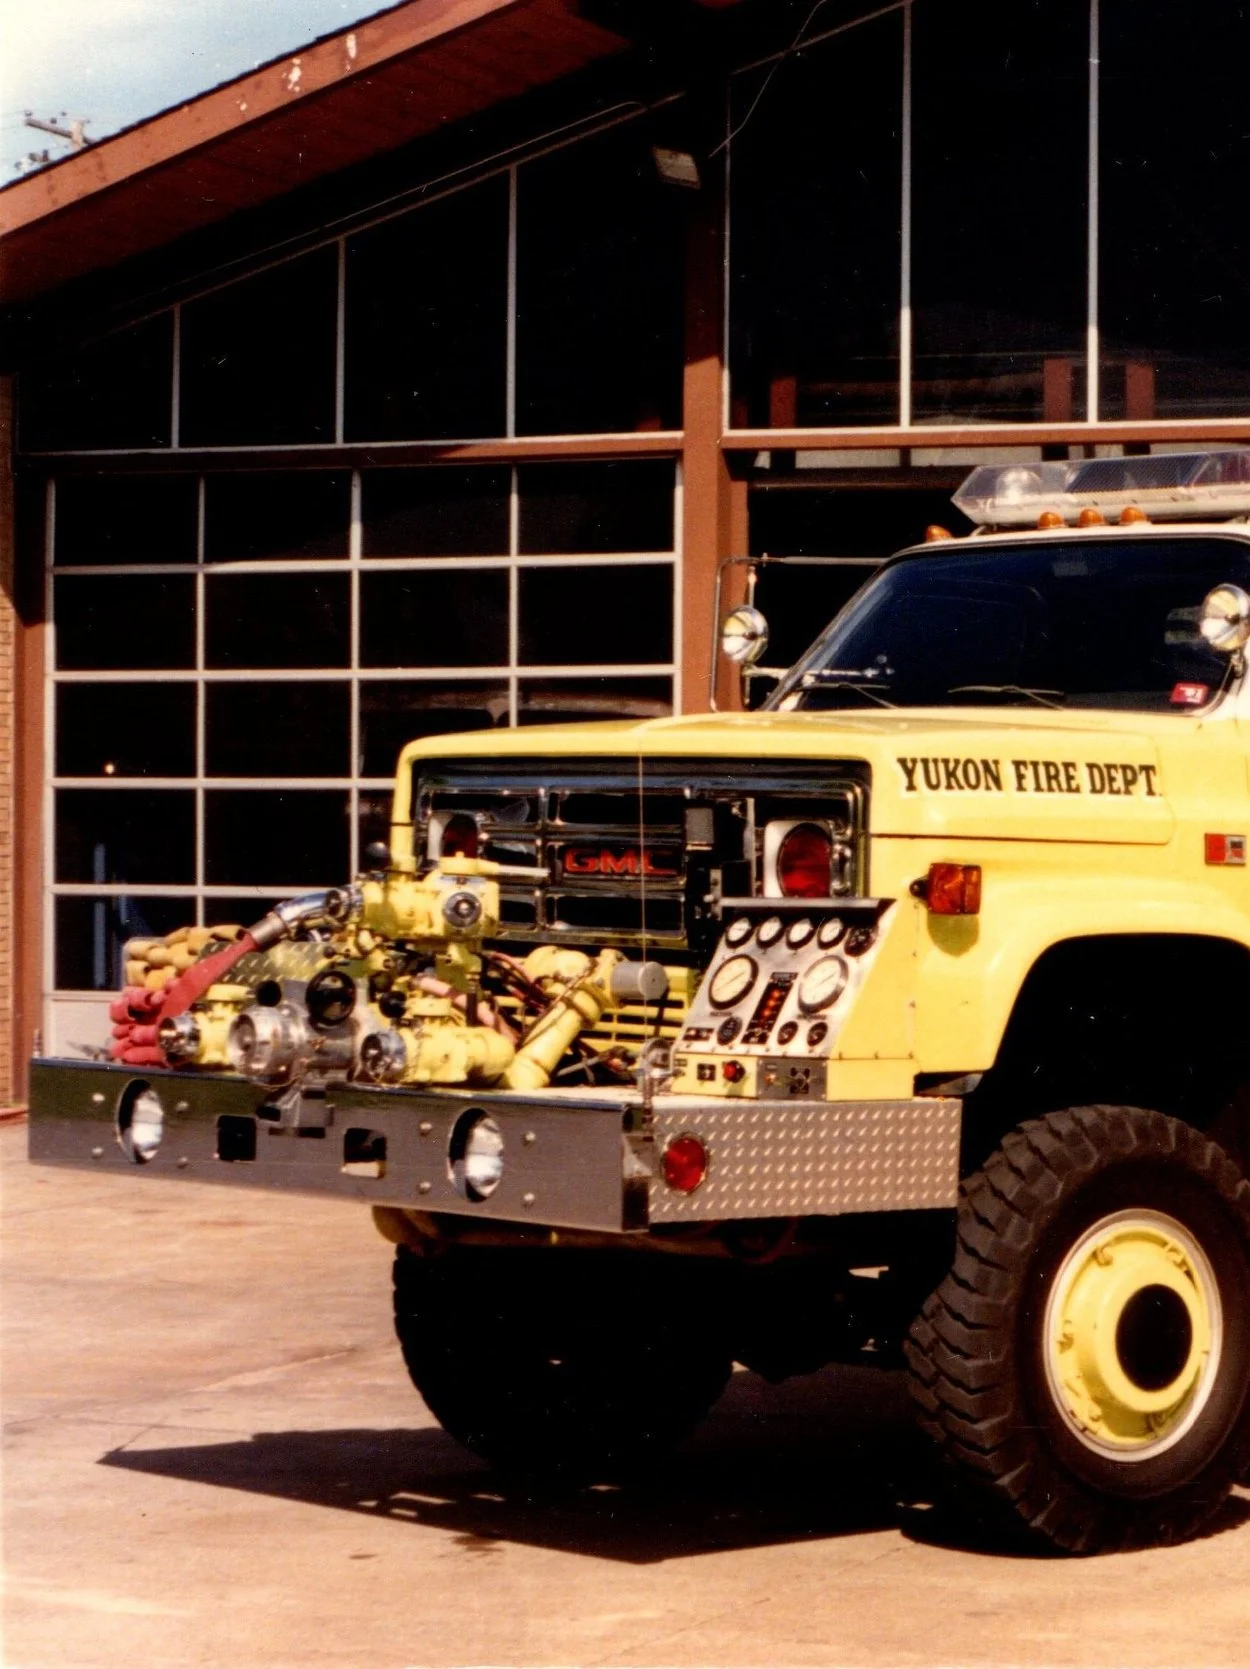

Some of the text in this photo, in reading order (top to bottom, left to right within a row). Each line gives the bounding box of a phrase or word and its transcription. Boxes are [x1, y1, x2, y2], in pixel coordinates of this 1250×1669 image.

[896, 757, 1003, 792] YUKON
[1011, 759, 1081, 793] FIRE
[565, 848, 677, 873] GMC
